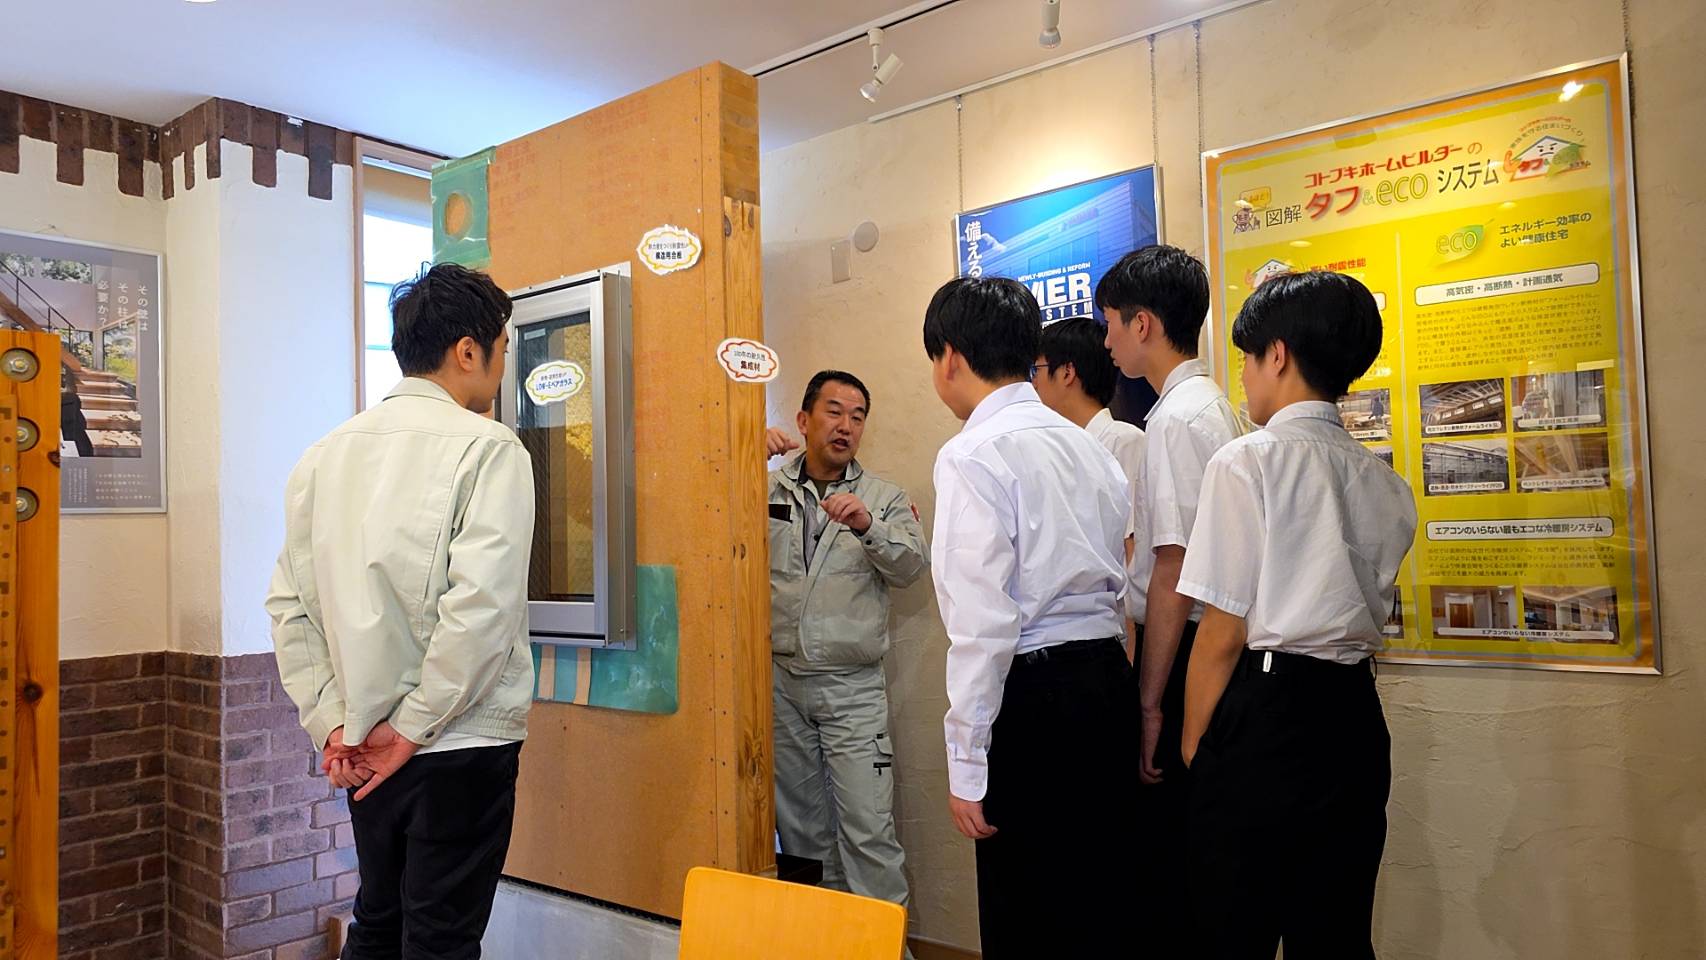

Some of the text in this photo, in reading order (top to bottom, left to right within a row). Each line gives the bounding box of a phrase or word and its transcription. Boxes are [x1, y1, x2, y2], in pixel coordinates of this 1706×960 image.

[1265, 204, 1302, 227] 図解
[1437, 159, 1499, 193] システム
[1500, 212, 1592, 235] エネルギー効率の
[964, 220, 983, 278] 備える
[1436, 231, 1477, 254] eco
[1067, 261, 1091, 272] REFORM
[1046, 301, 1092, 321] STEM
[740, 360, 761, 372] 集成材
[1435, 522, 1603, 535] エアコンのいらない最もエコな冷暖房システム
